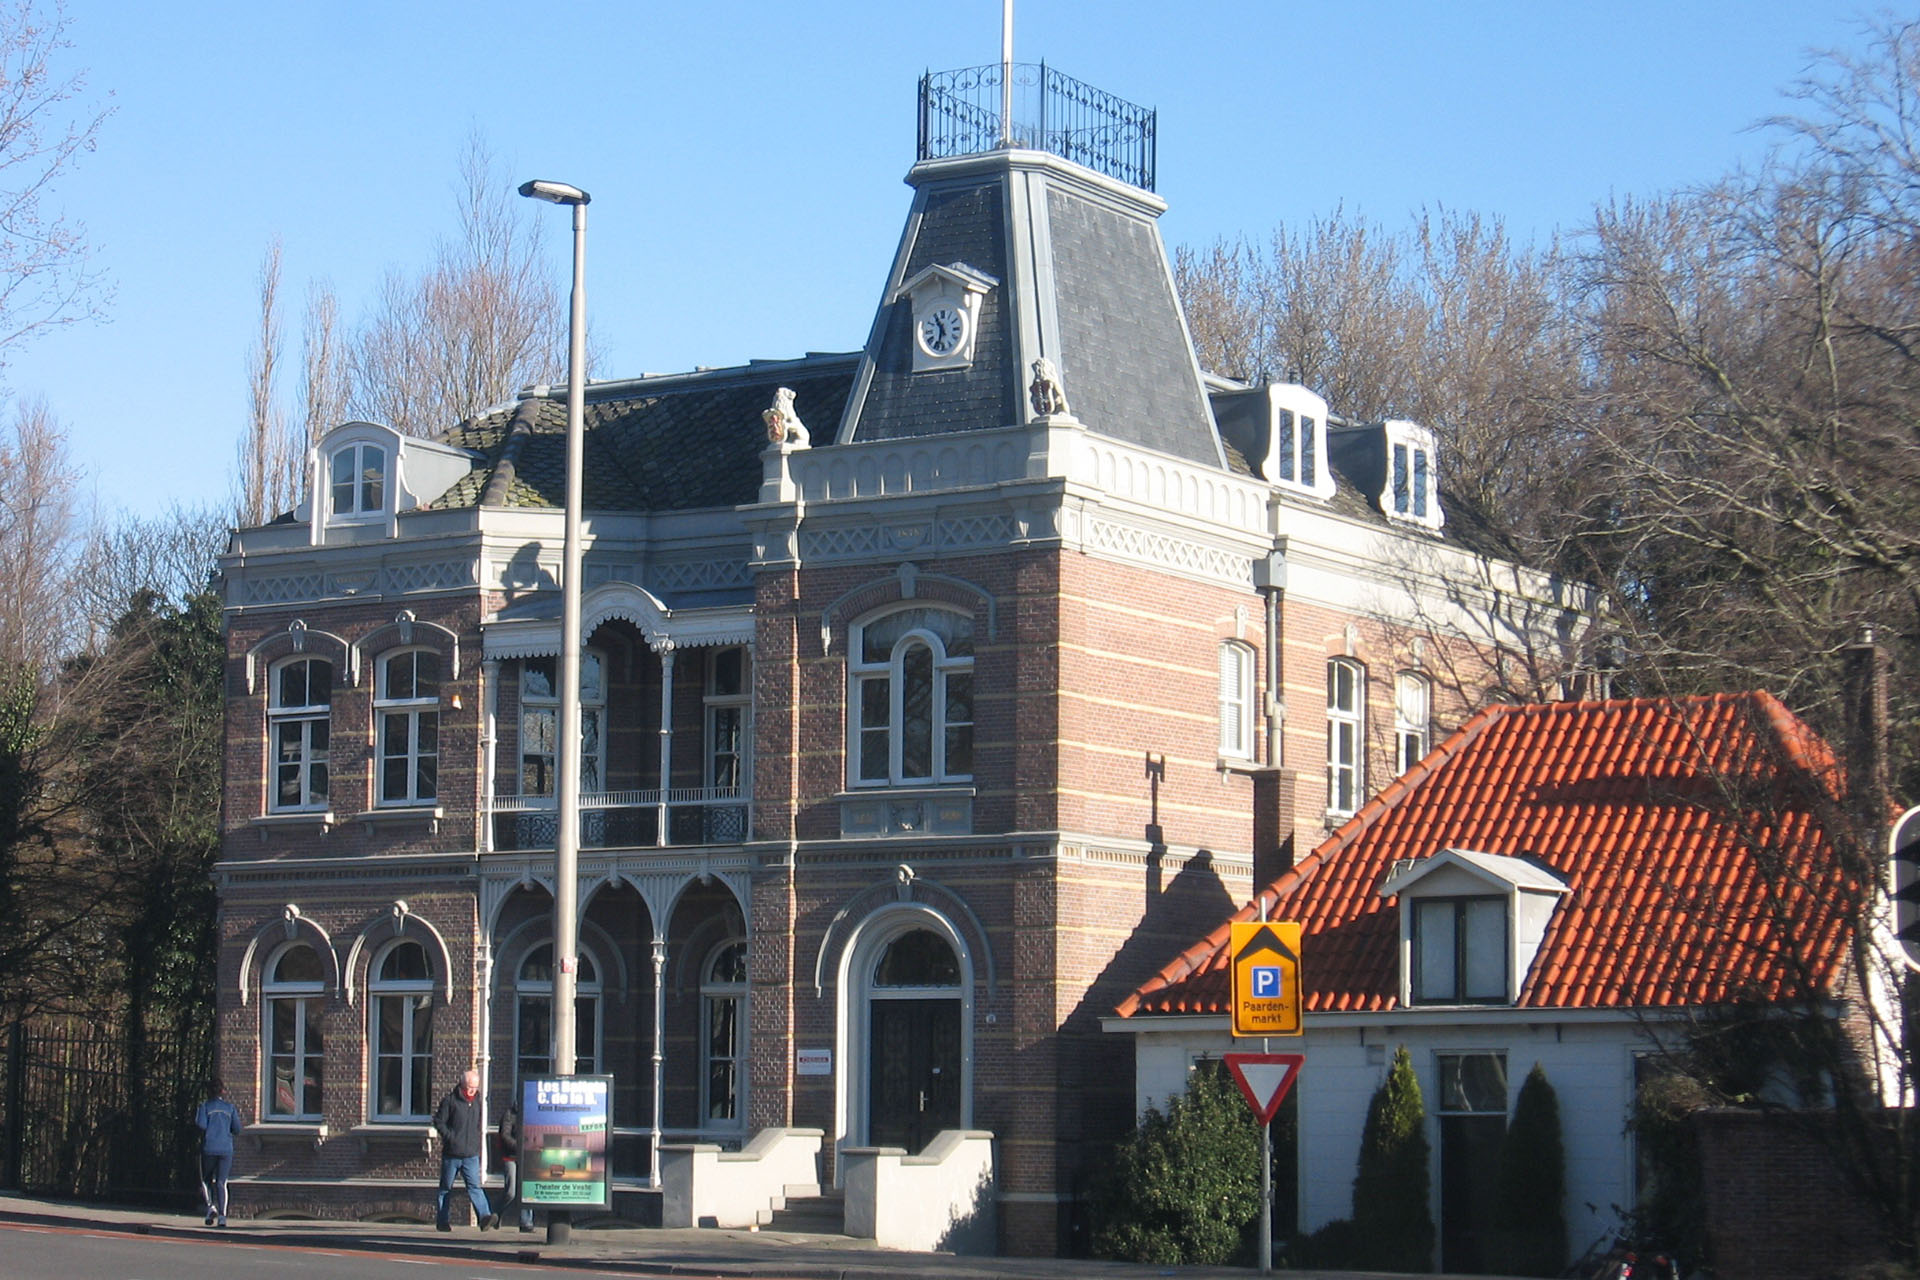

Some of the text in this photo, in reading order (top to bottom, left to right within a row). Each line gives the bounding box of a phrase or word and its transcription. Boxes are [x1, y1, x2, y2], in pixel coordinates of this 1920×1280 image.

[1258, 971, 1273, 994] P
[1243, 1001, 1289, 1012] Paarden-
[1251, 1014, 1282, 1024] markt
